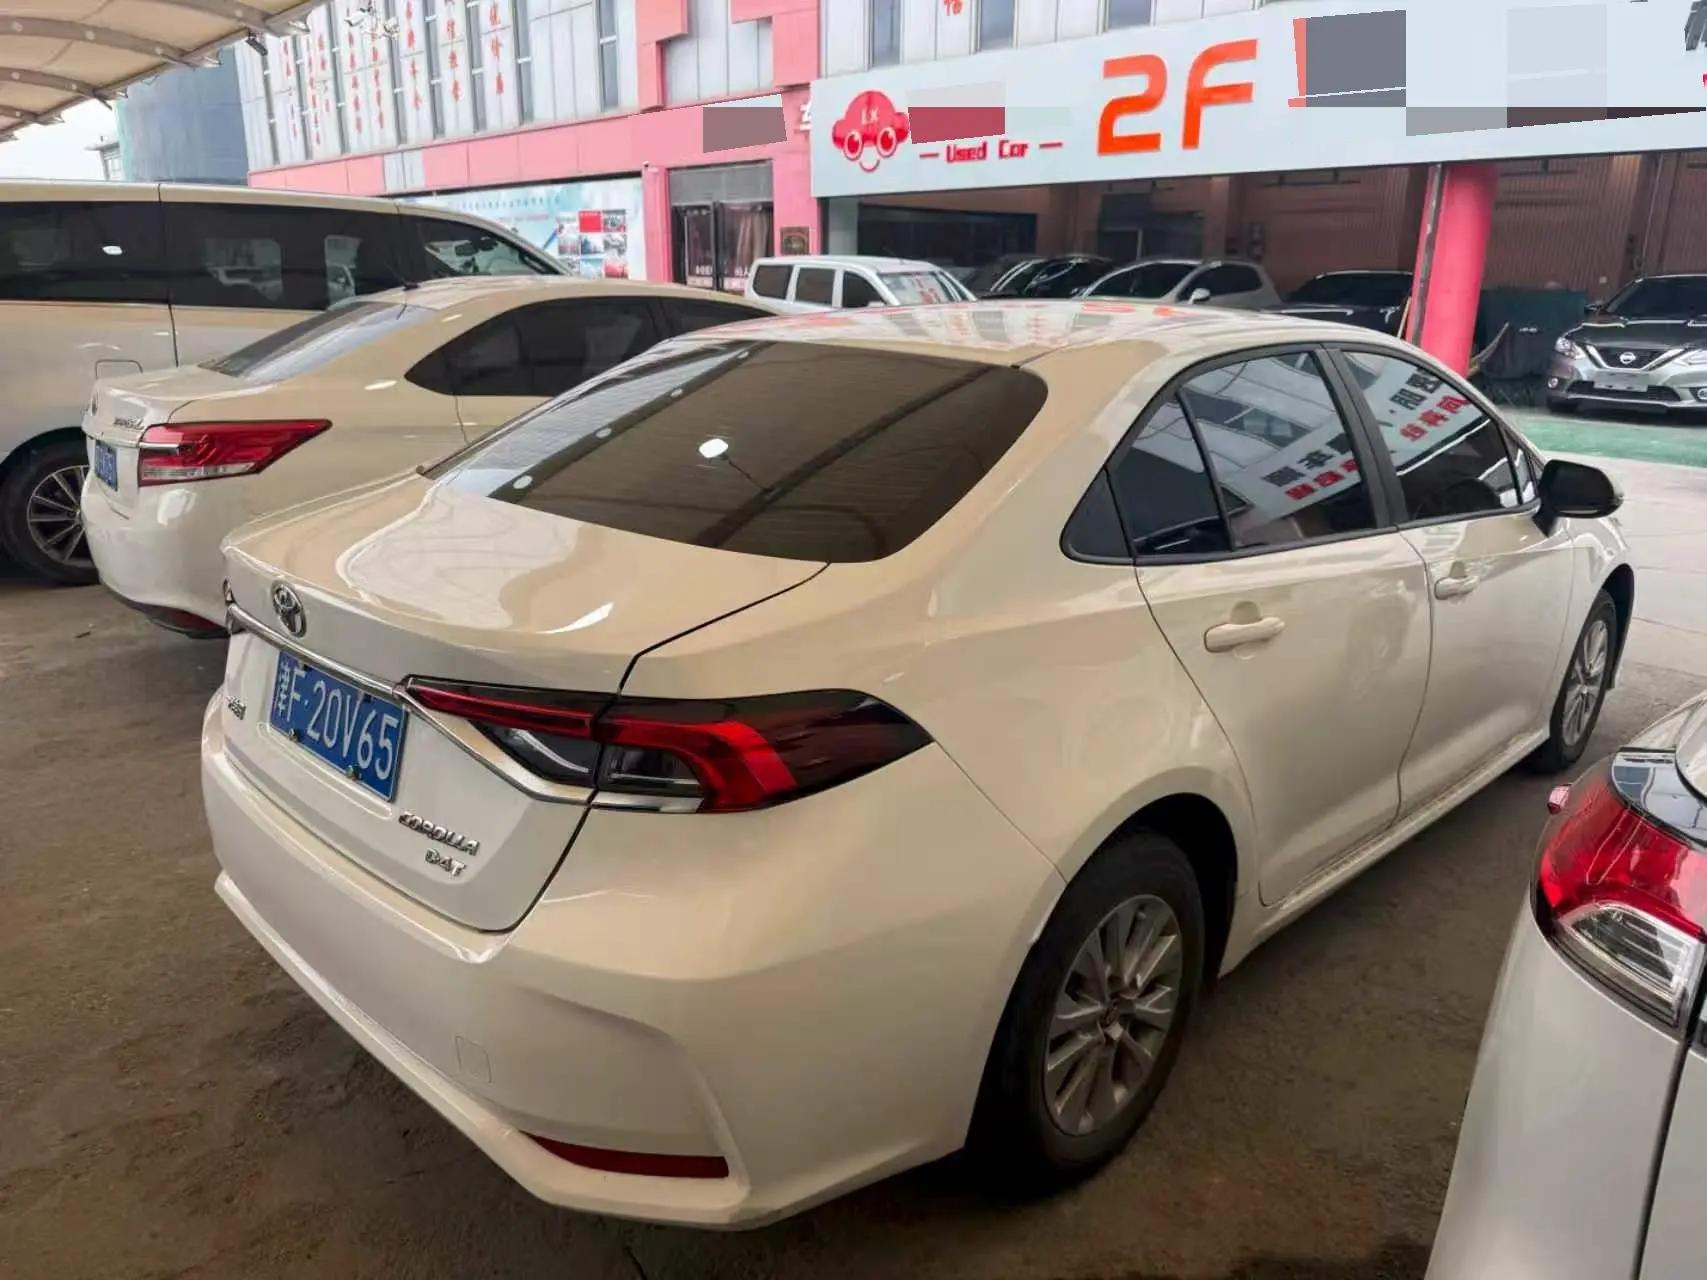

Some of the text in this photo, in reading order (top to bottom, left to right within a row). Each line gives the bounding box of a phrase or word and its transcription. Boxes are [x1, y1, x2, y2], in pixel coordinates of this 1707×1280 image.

[1097, 38, 1258, 157] 2F
[945, 138, 1030, 164] Used Car
[398, 811, 480, 857] COROLLA
